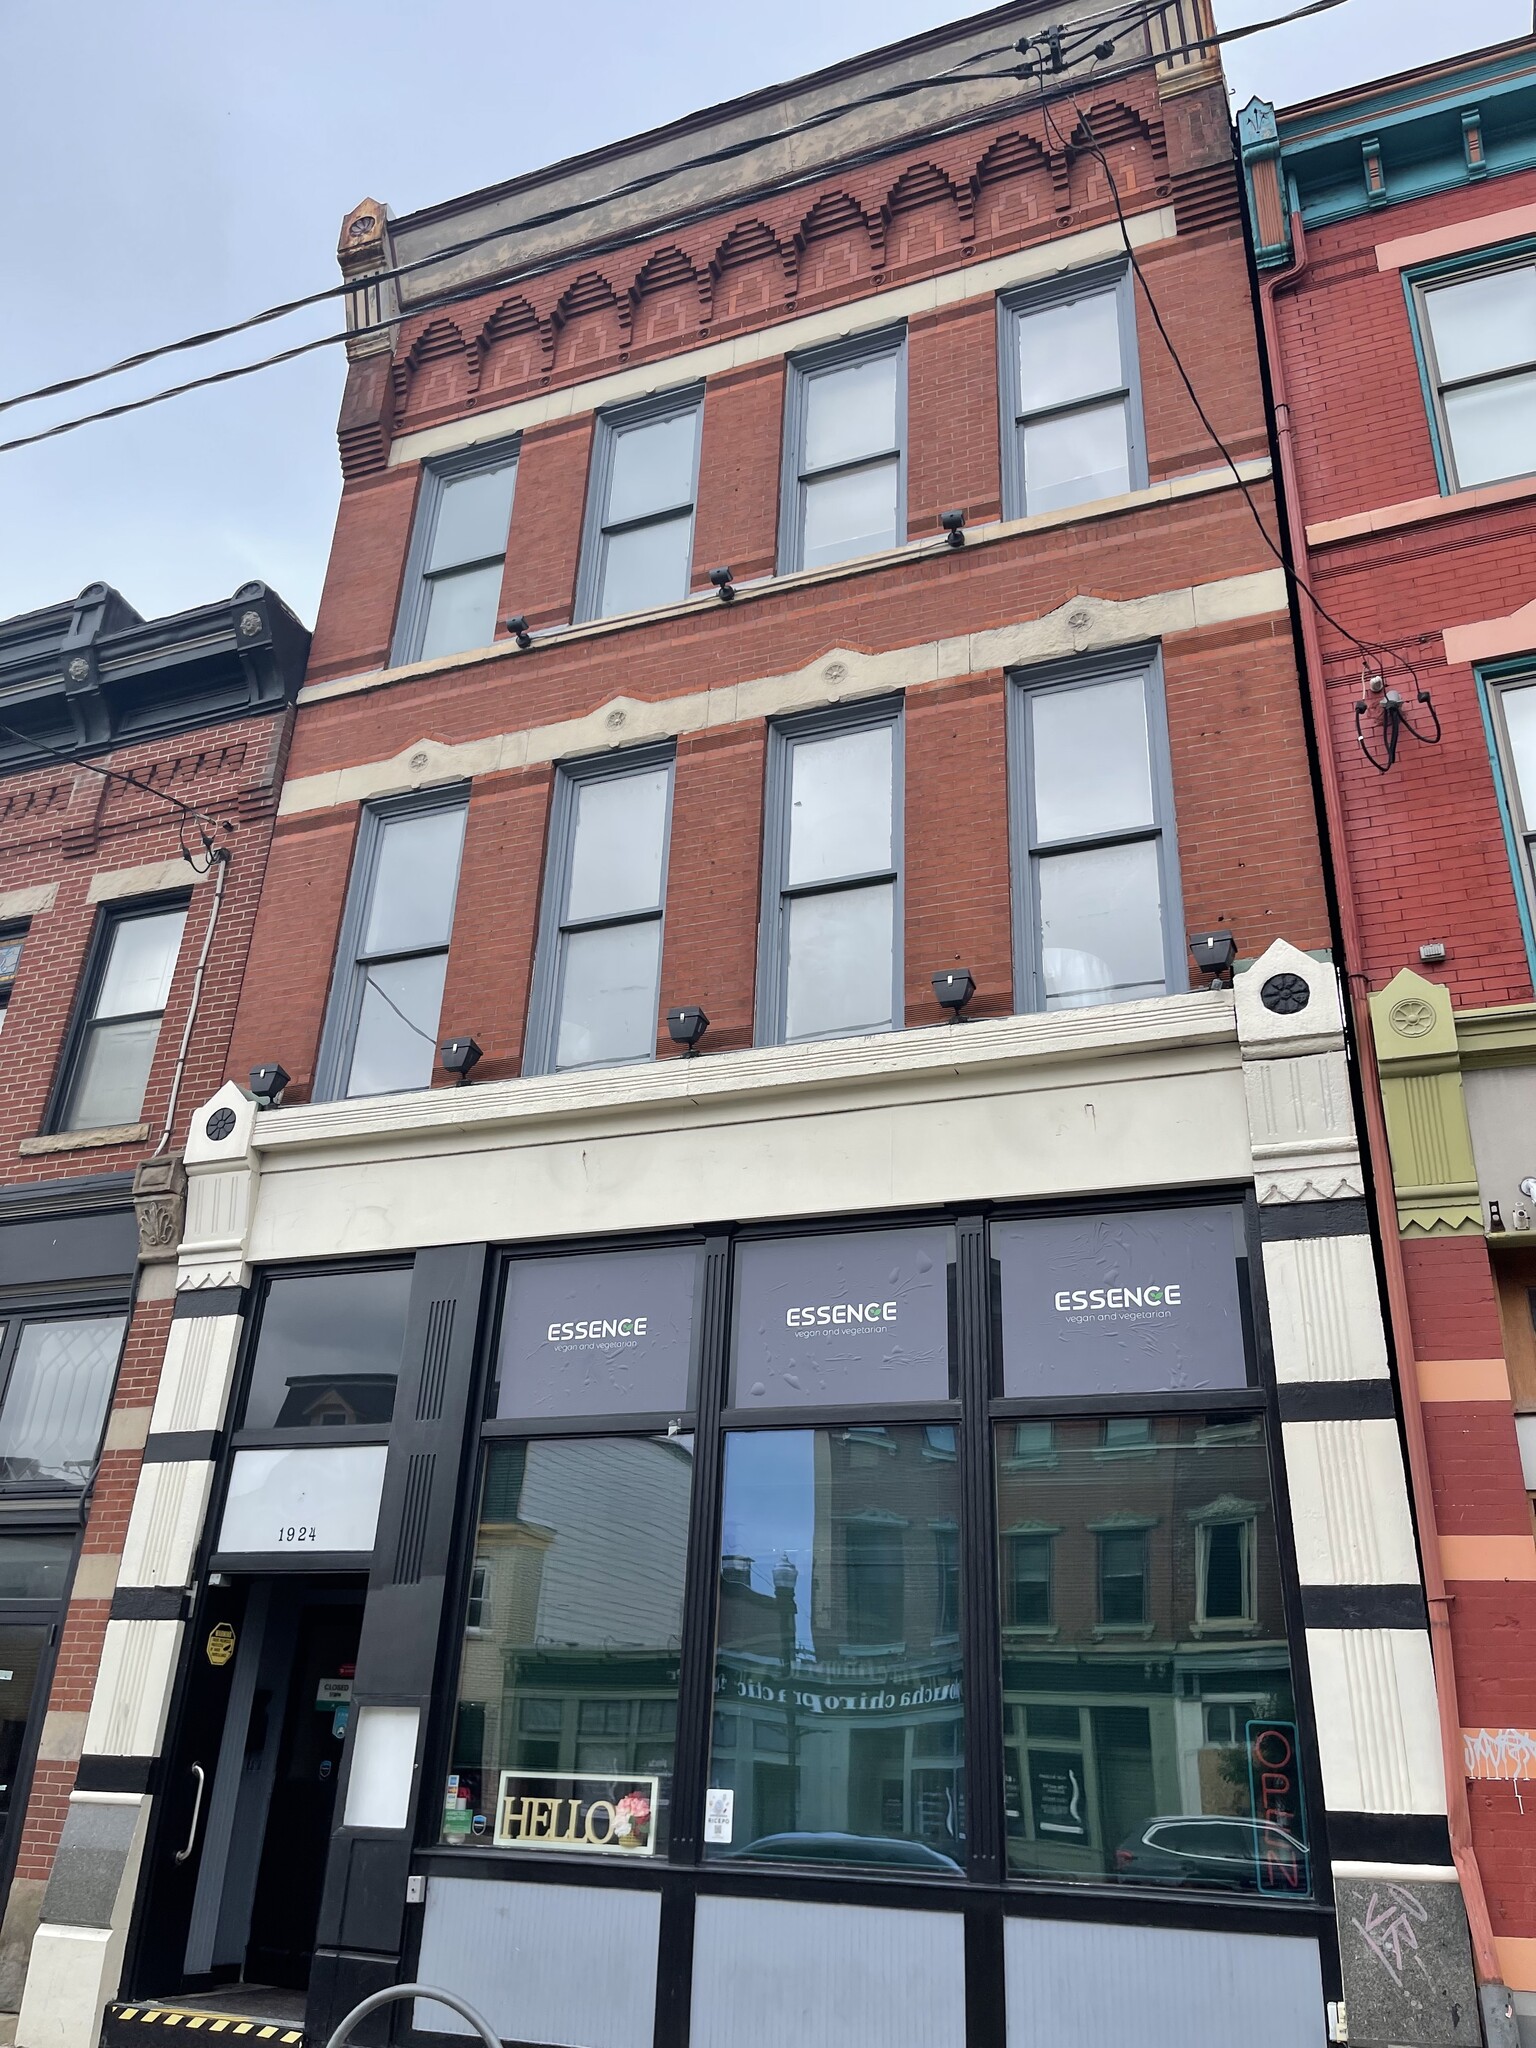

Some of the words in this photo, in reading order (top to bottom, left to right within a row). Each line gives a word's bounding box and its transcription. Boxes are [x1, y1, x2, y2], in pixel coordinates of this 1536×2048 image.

[1055, 1284, 1181, 1311] ESSENCE
[786, 1301, 897, 1327] ESSENCE
[1065, 1314, 1095, 1324] vegan
[1097, 1312, 1117, 1321] and
[1118, 1310, 1172, 1321] vegetarian
[547, 1317, 648, 1341] ESSENCE
[794, 1329, 820, 1339] vegan
[822, 1327, 840, 1336] and
[841, 1325, 888, 1337] vegetarian
[554, 1343, 578, 1353] vegan
[579, 1342, 595, 1350] and
[596, 1340, 638, 1351] vegetarian
[278, 1526, 317, 1542] 1924
[500, 1796, 617, 1844] HELLO
[1255, 1730, 1299, 1888] OPEN
